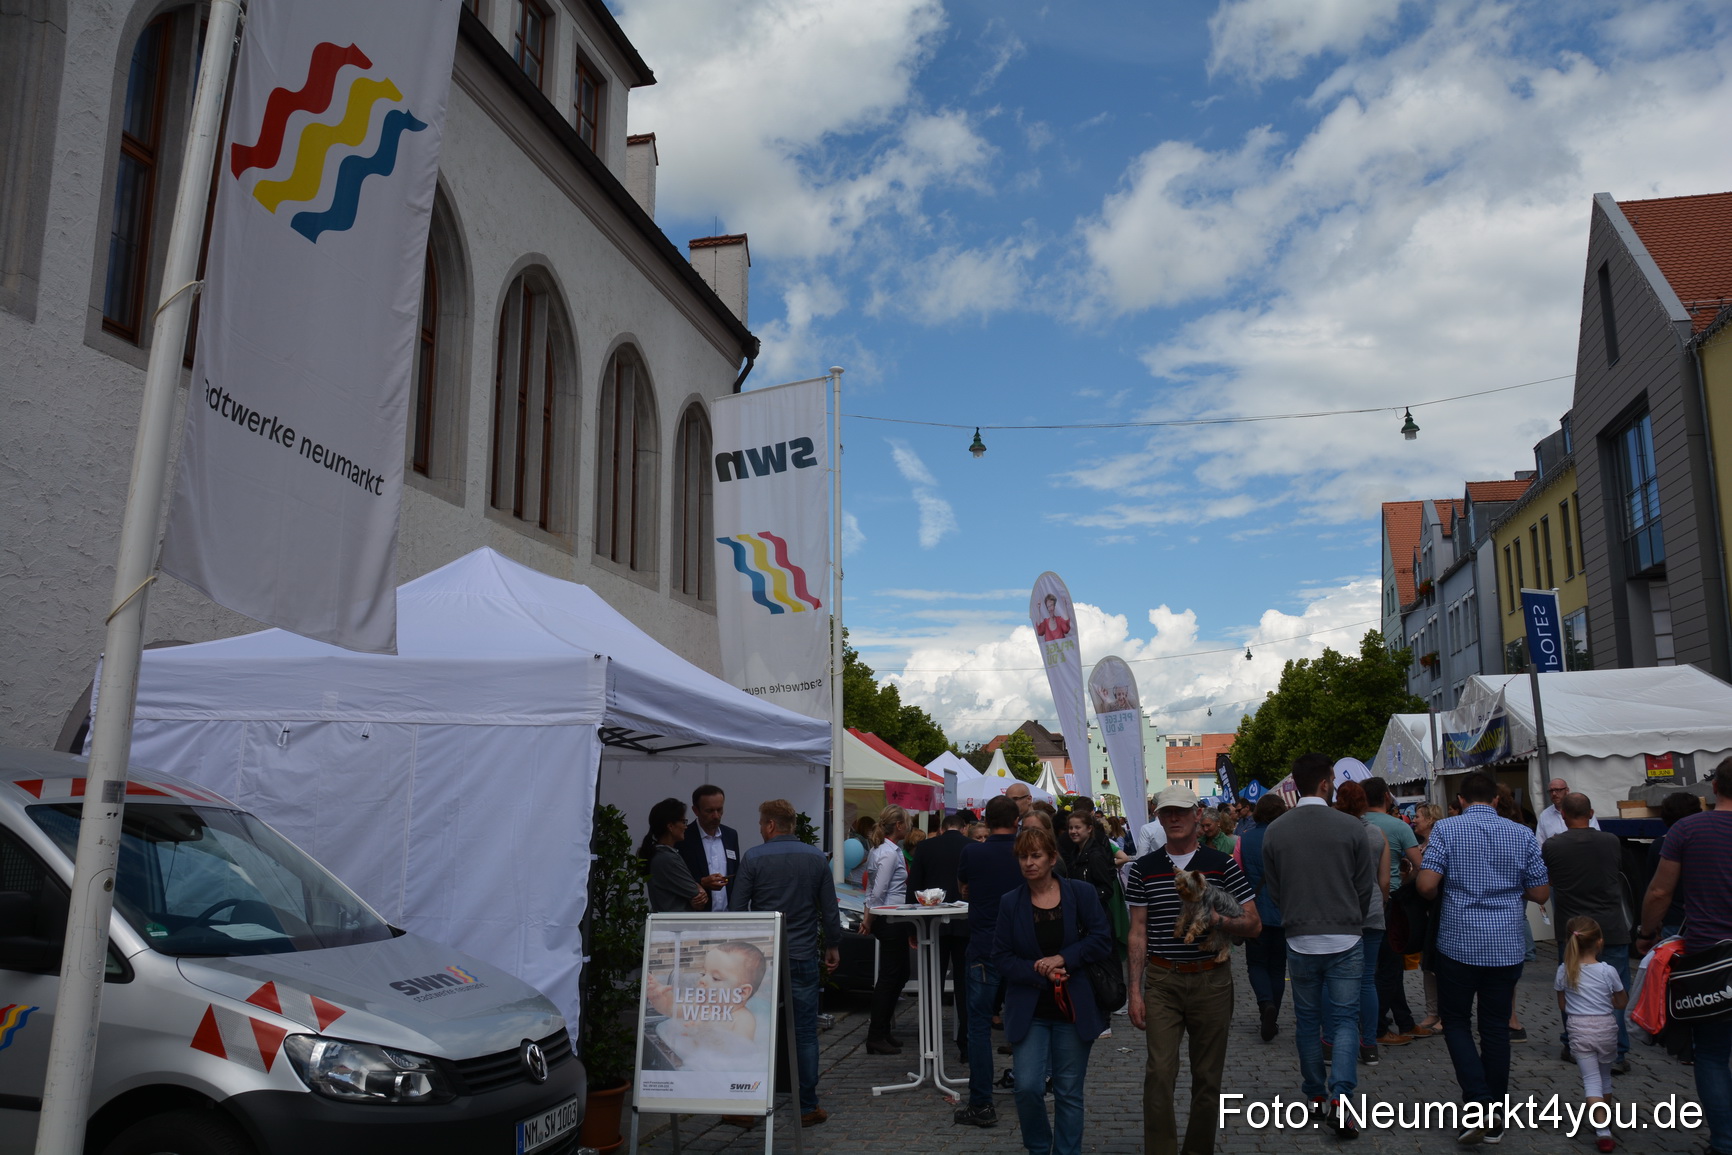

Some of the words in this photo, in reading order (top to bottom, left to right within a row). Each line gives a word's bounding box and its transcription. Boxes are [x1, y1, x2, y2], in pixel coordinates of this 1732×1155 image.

[299, 436, 384, 496] neumarkt
[389, 973, 463, 996] swn
[675, 987, 743, 1004] LEBENS
[1675, 992, 1721, 1010] adidas
[682, 1005, 734, 1021] WERK
[525, 1120, 538, 1148] NM
[544, 1112, 556, 1138] SW
[557, 1101, 577, 1131] 1003
